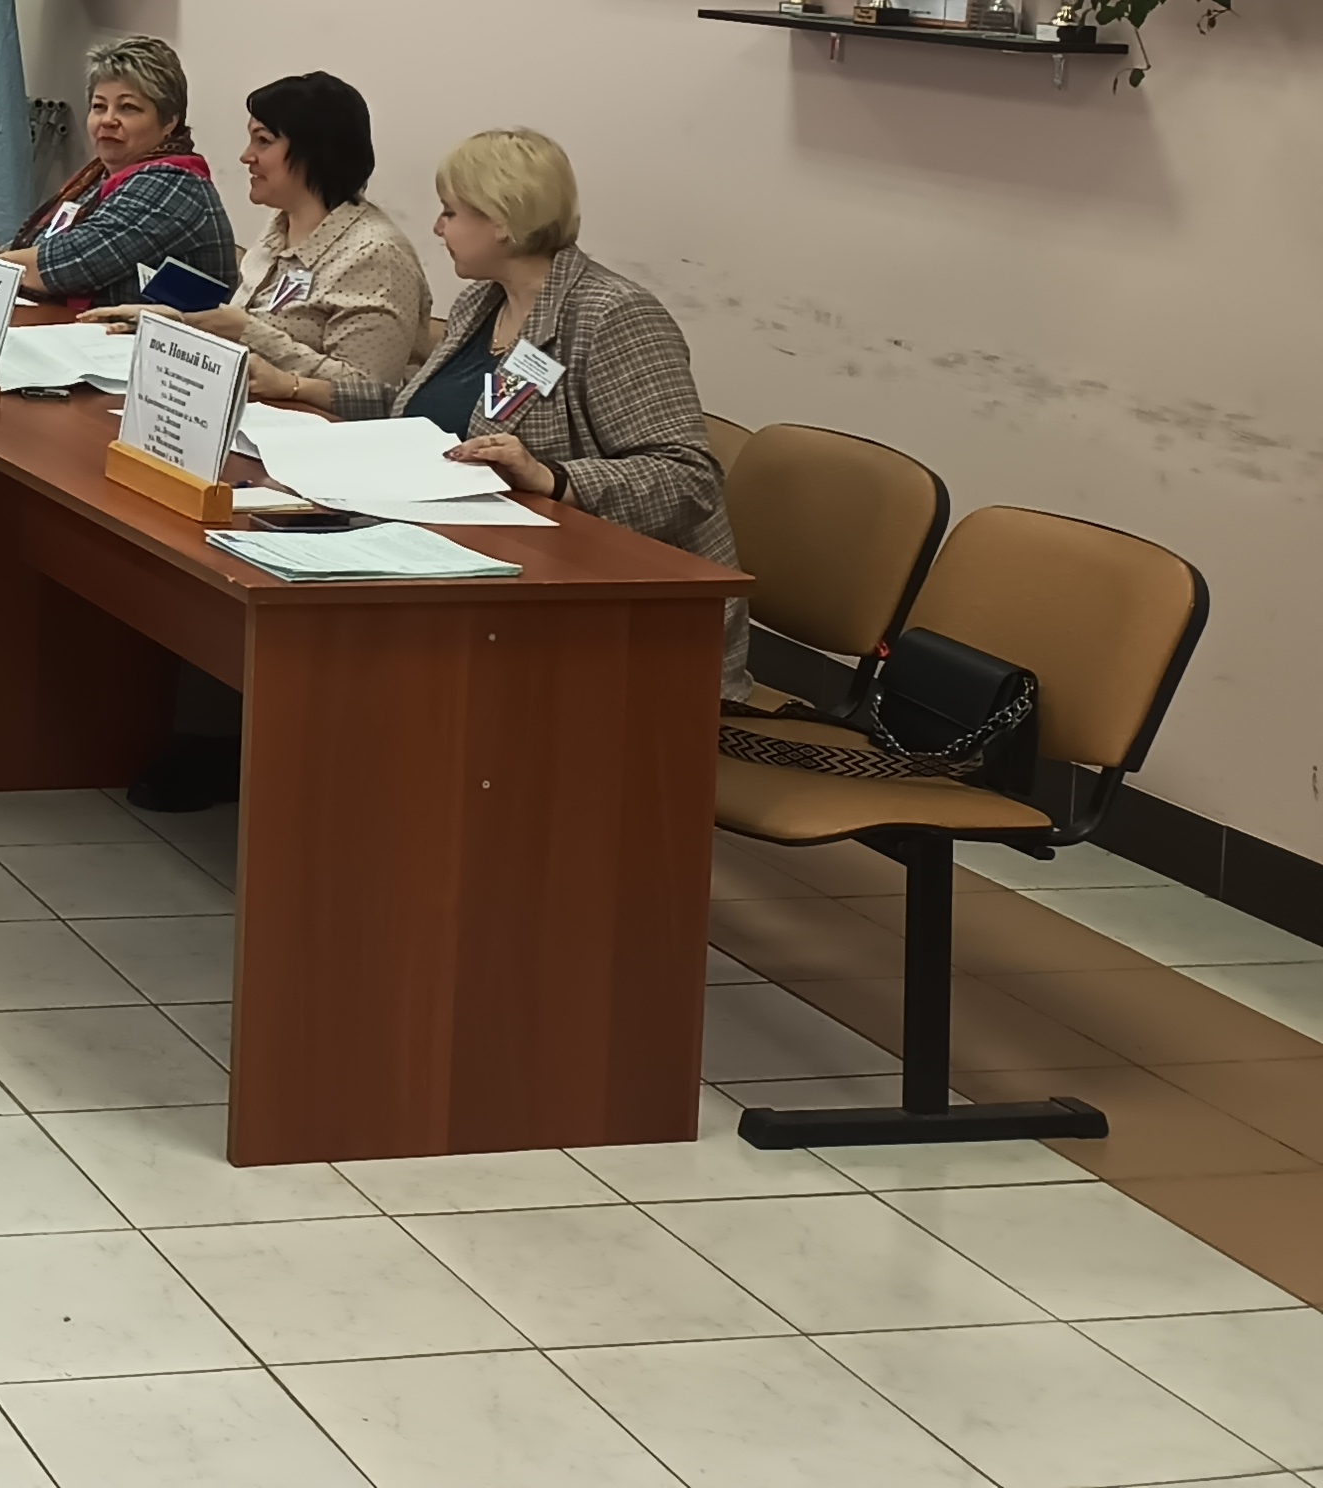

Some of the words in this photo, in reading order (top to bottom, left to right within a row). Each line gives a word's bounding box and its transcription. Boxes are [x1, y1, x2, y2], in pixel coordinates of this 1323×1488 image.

[149, 338, 167, 354] пос.
[168, 342, 200, 366] Новый
[201, 354, 222, 375] Быт
